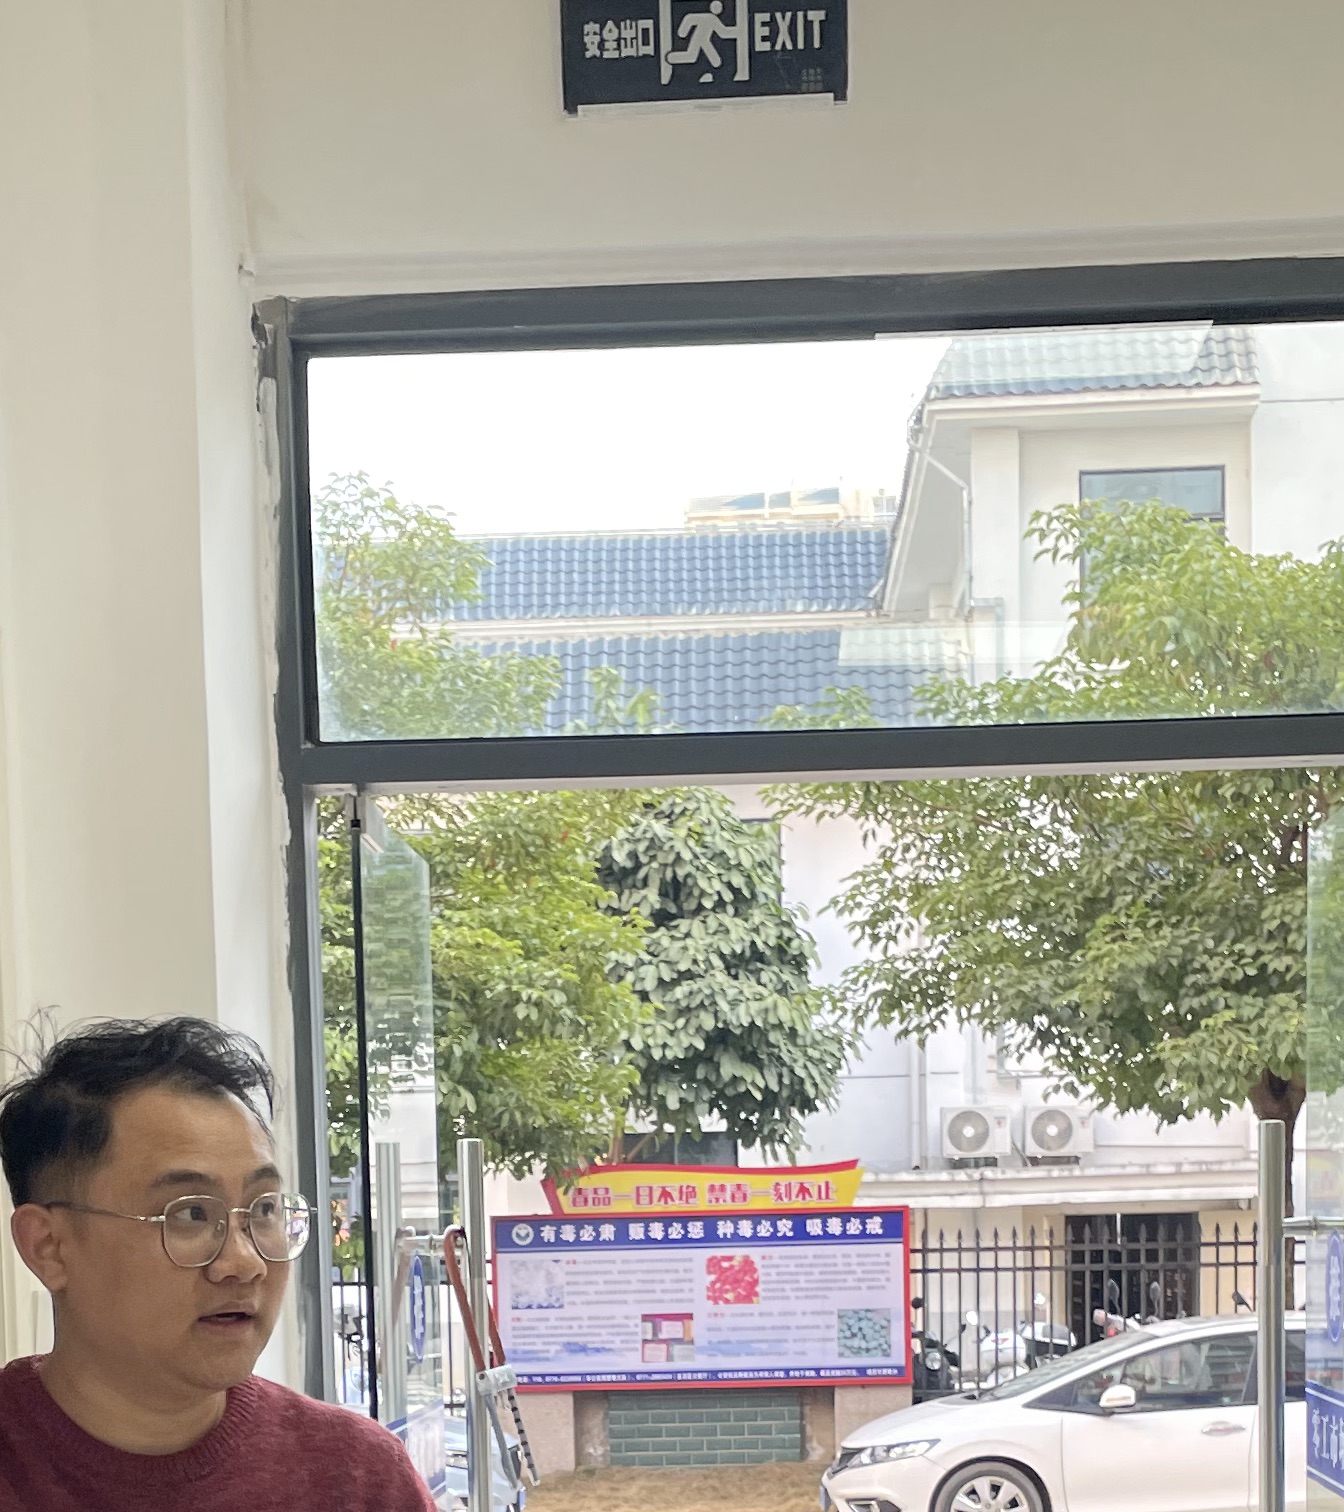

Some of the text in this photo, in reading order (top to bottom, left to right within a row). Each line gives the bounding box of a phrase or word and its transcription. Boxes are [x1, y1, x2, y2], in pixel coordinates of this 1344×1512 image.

[582, 19, 655, 59] 安全出口
[754, 9, 827, 52] EXIT
[569, 1180, 837, 1208] 毒品一日不绝 禁毒一刻不止
[540, 1216, 883, 1243] 有毒必肃 贩毒必惩 种毒必究 吸毒必戒
